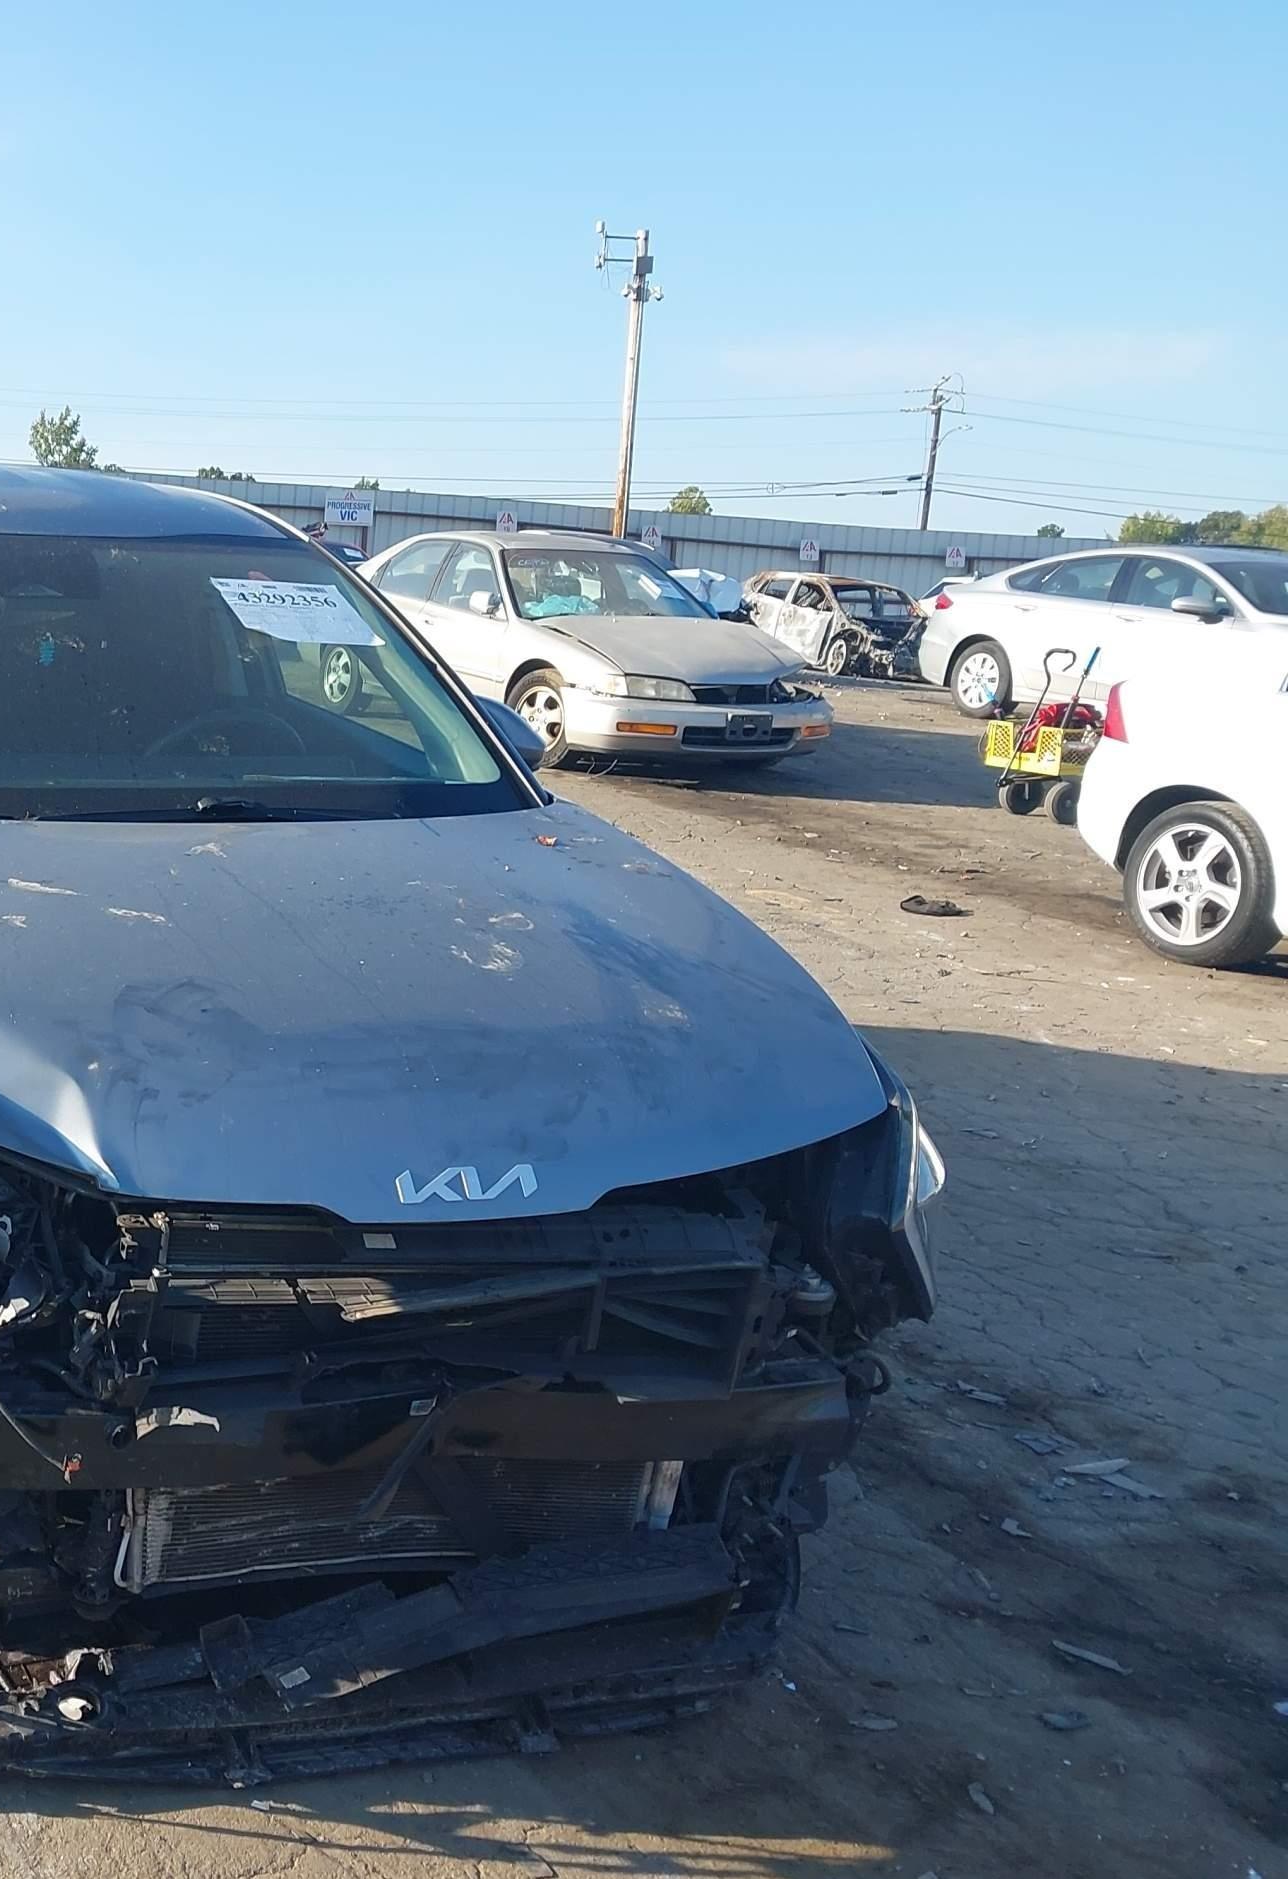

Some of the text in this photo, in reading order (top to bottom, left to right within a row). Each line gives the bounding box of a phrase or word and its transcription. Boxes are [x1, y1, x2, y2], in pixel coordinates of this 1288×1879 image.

[327, 501, 372, 511] PROGRESSIVE
[339, 510, 358, 521] VIC
[237, 592, 337, 609] 43292356
[395, 1163, 539, 1205] KIA
